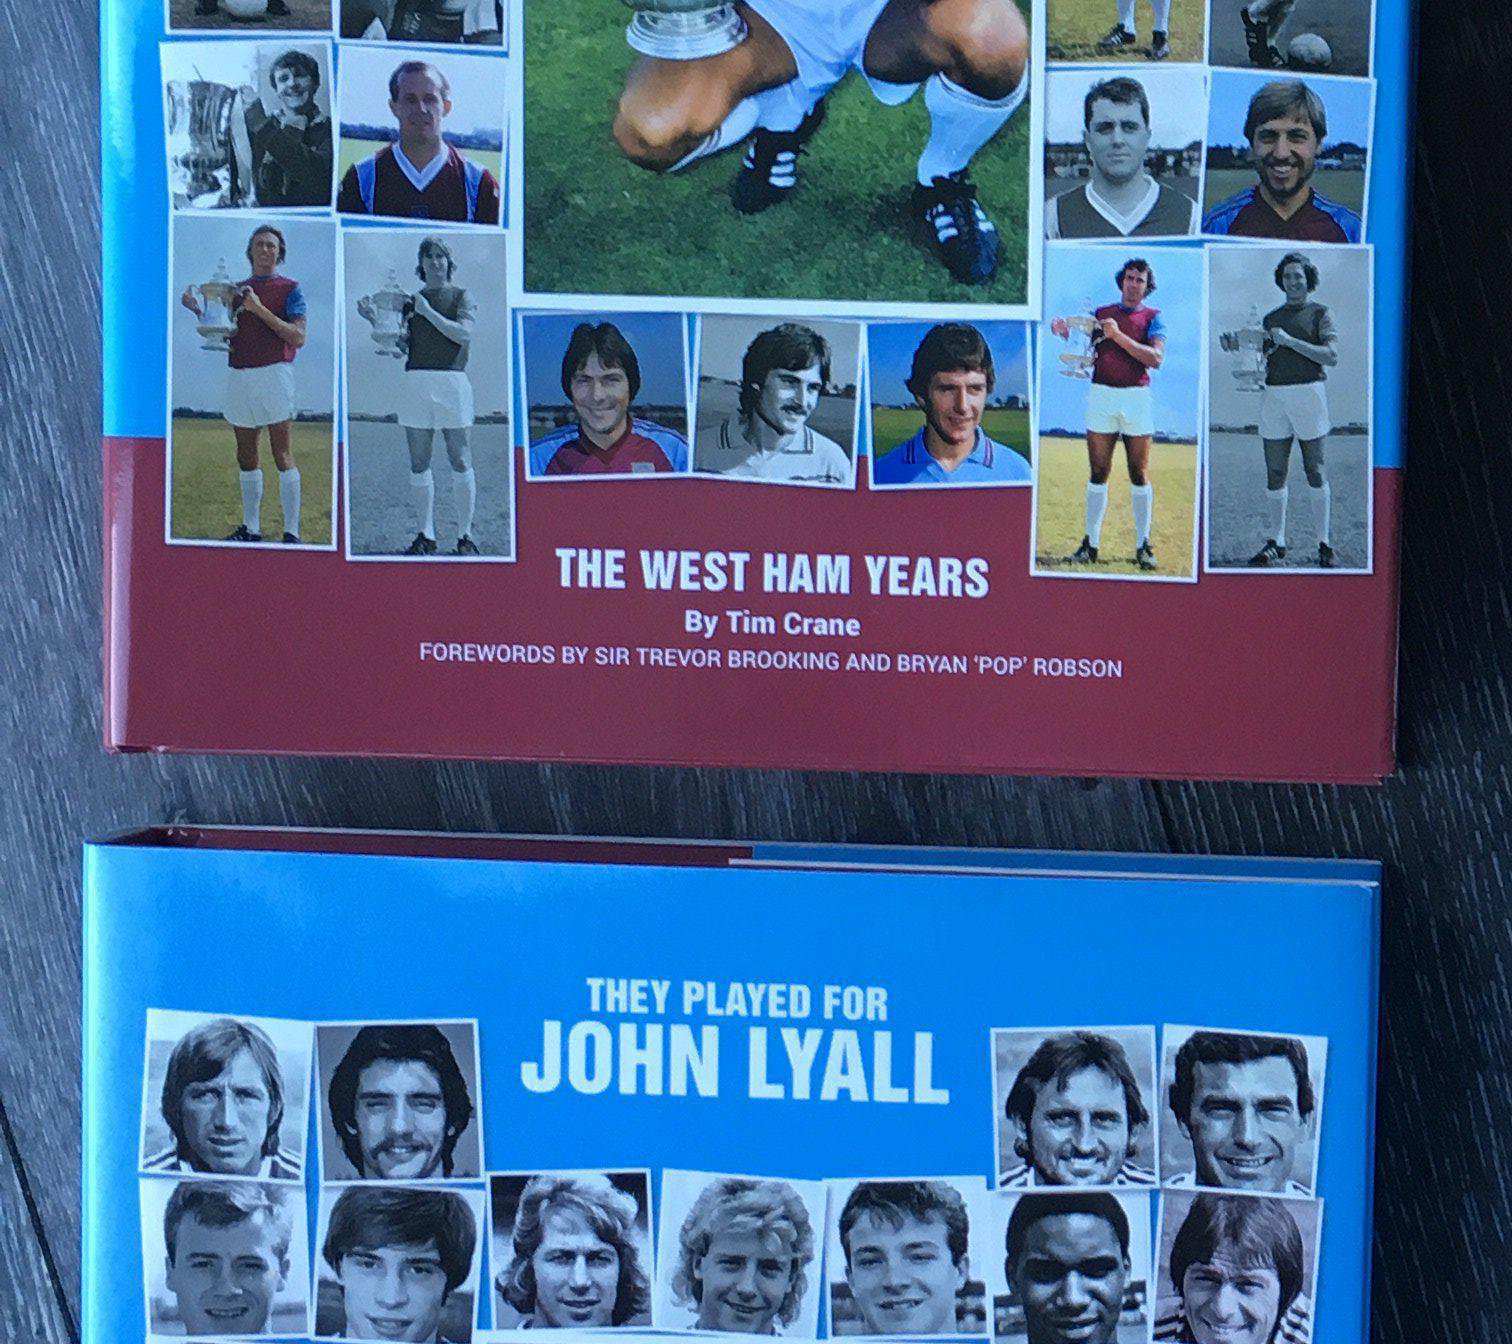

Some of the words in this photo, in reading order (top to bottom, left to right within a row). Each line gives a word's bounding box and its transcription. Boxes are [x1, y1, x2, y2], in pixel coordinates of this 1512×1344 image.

[555, 547, 626, 589] THE
[639, 549, 751, 592] WEST
[763, 552, 850, 594] HAM
[864, 555, 989, 598] YEARS
[684, 609, 719, 639] By
[725, 609, 776, 635] Tim
[783, 611, 861, 637] Crane
[420, 642, 556, 664] FOREWORDS
[561, 645, 590, 665] BY
[594, 646, 630, 666] SIR
[635, 647, 722, 668] TREVOR
[727, 649, 840, 671] BROOKING
[845, 652, 891, 672] AND
[897, 653, 968, 674] BRYAN
[1033, 657, 1122, 678] ROBSON
[586, 977, 671, 1014] THEY
[682, 980, 811, 1019] PLAYED
[823, 984, 888, 1022] FOR
[520, 1020, 720, 1097] JOHN
[748, 1026, 950, 1105] LYALL
